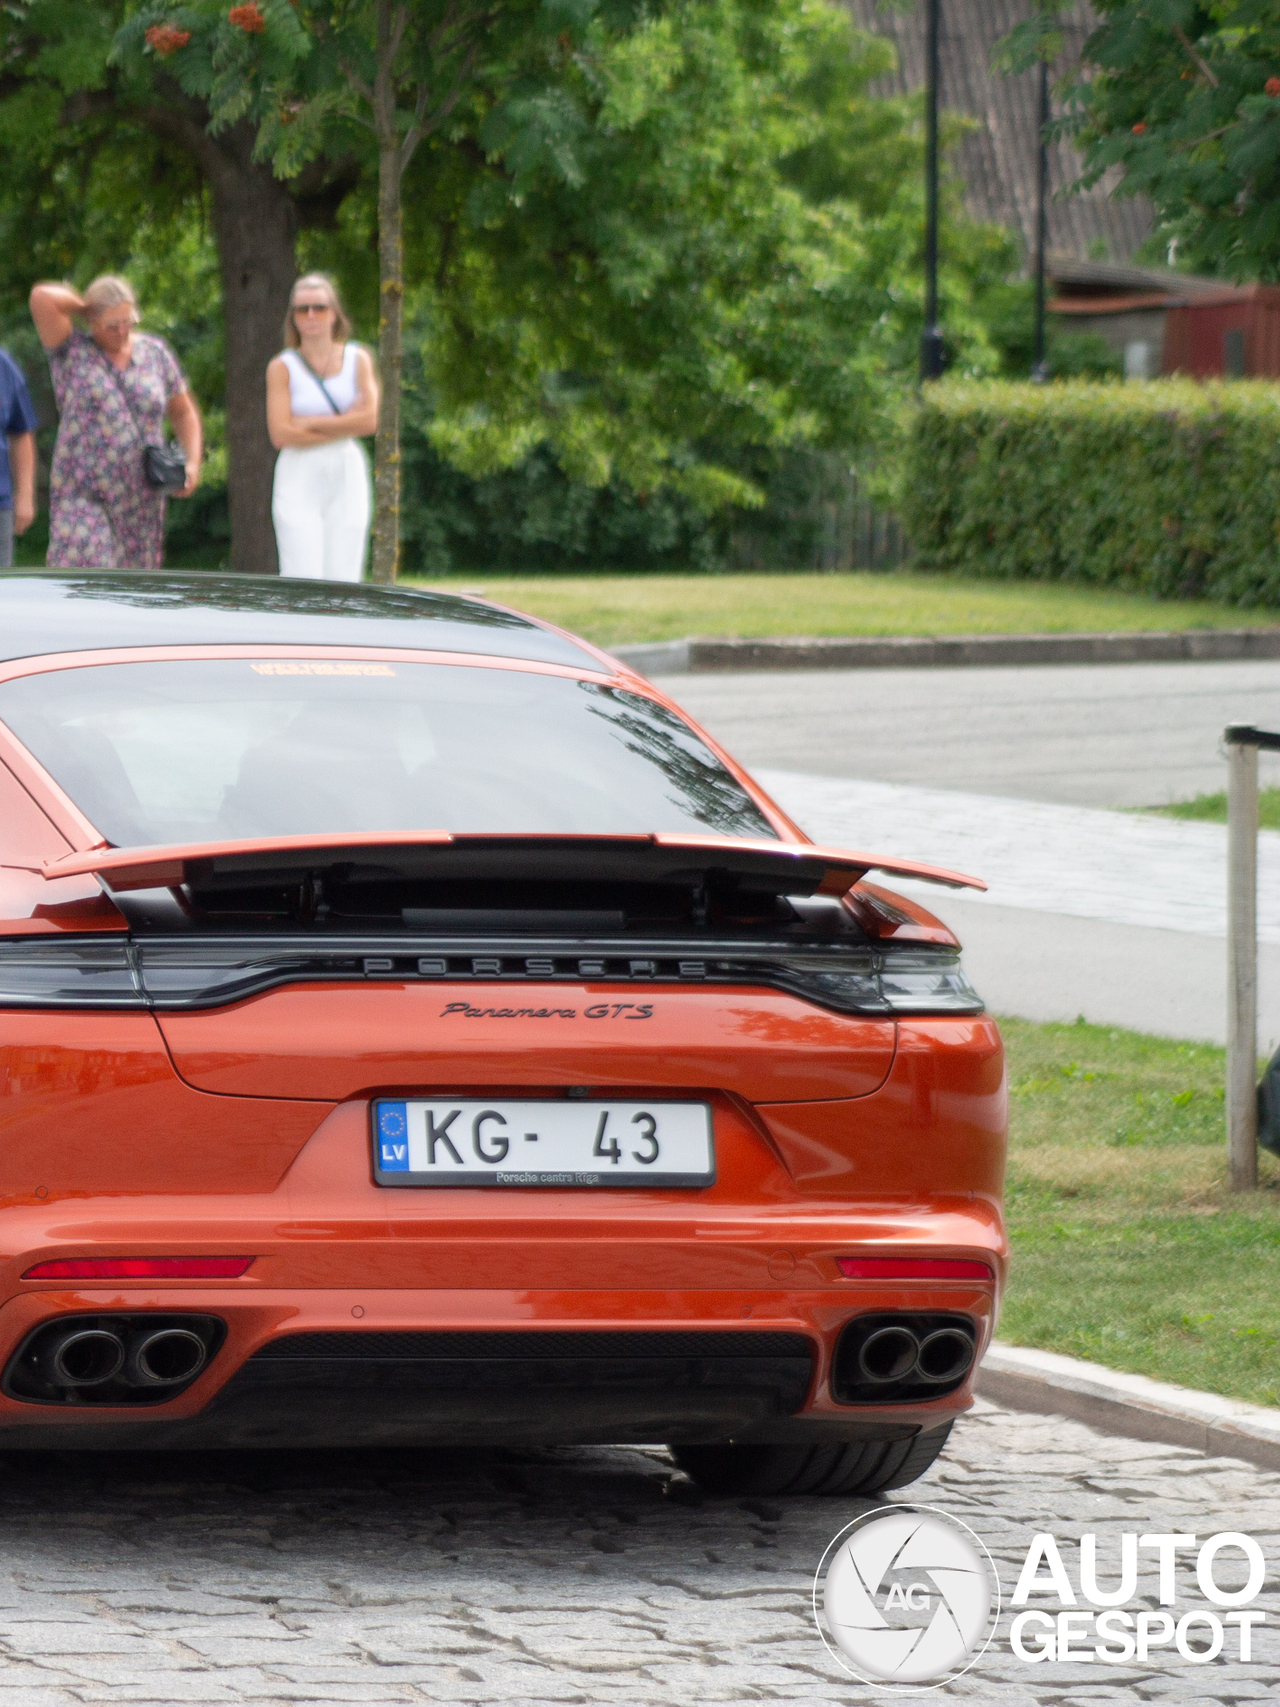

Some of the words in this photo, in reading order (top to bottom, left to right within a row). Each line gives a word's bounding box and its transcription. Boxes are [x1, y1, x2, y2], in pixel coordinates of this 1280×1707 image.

[363, 957, 706, 979] PORSCHE
[439, 1002, 575, 1018] Panamera
[583, 1003, 654, 1019] GTS
[592, 1110, 660, 1165] 43
[382, 1145, 405, 1161] LV
[496, 1171, 538, 1183] Porsche
[540, 1173, 573, 1183] centrs
